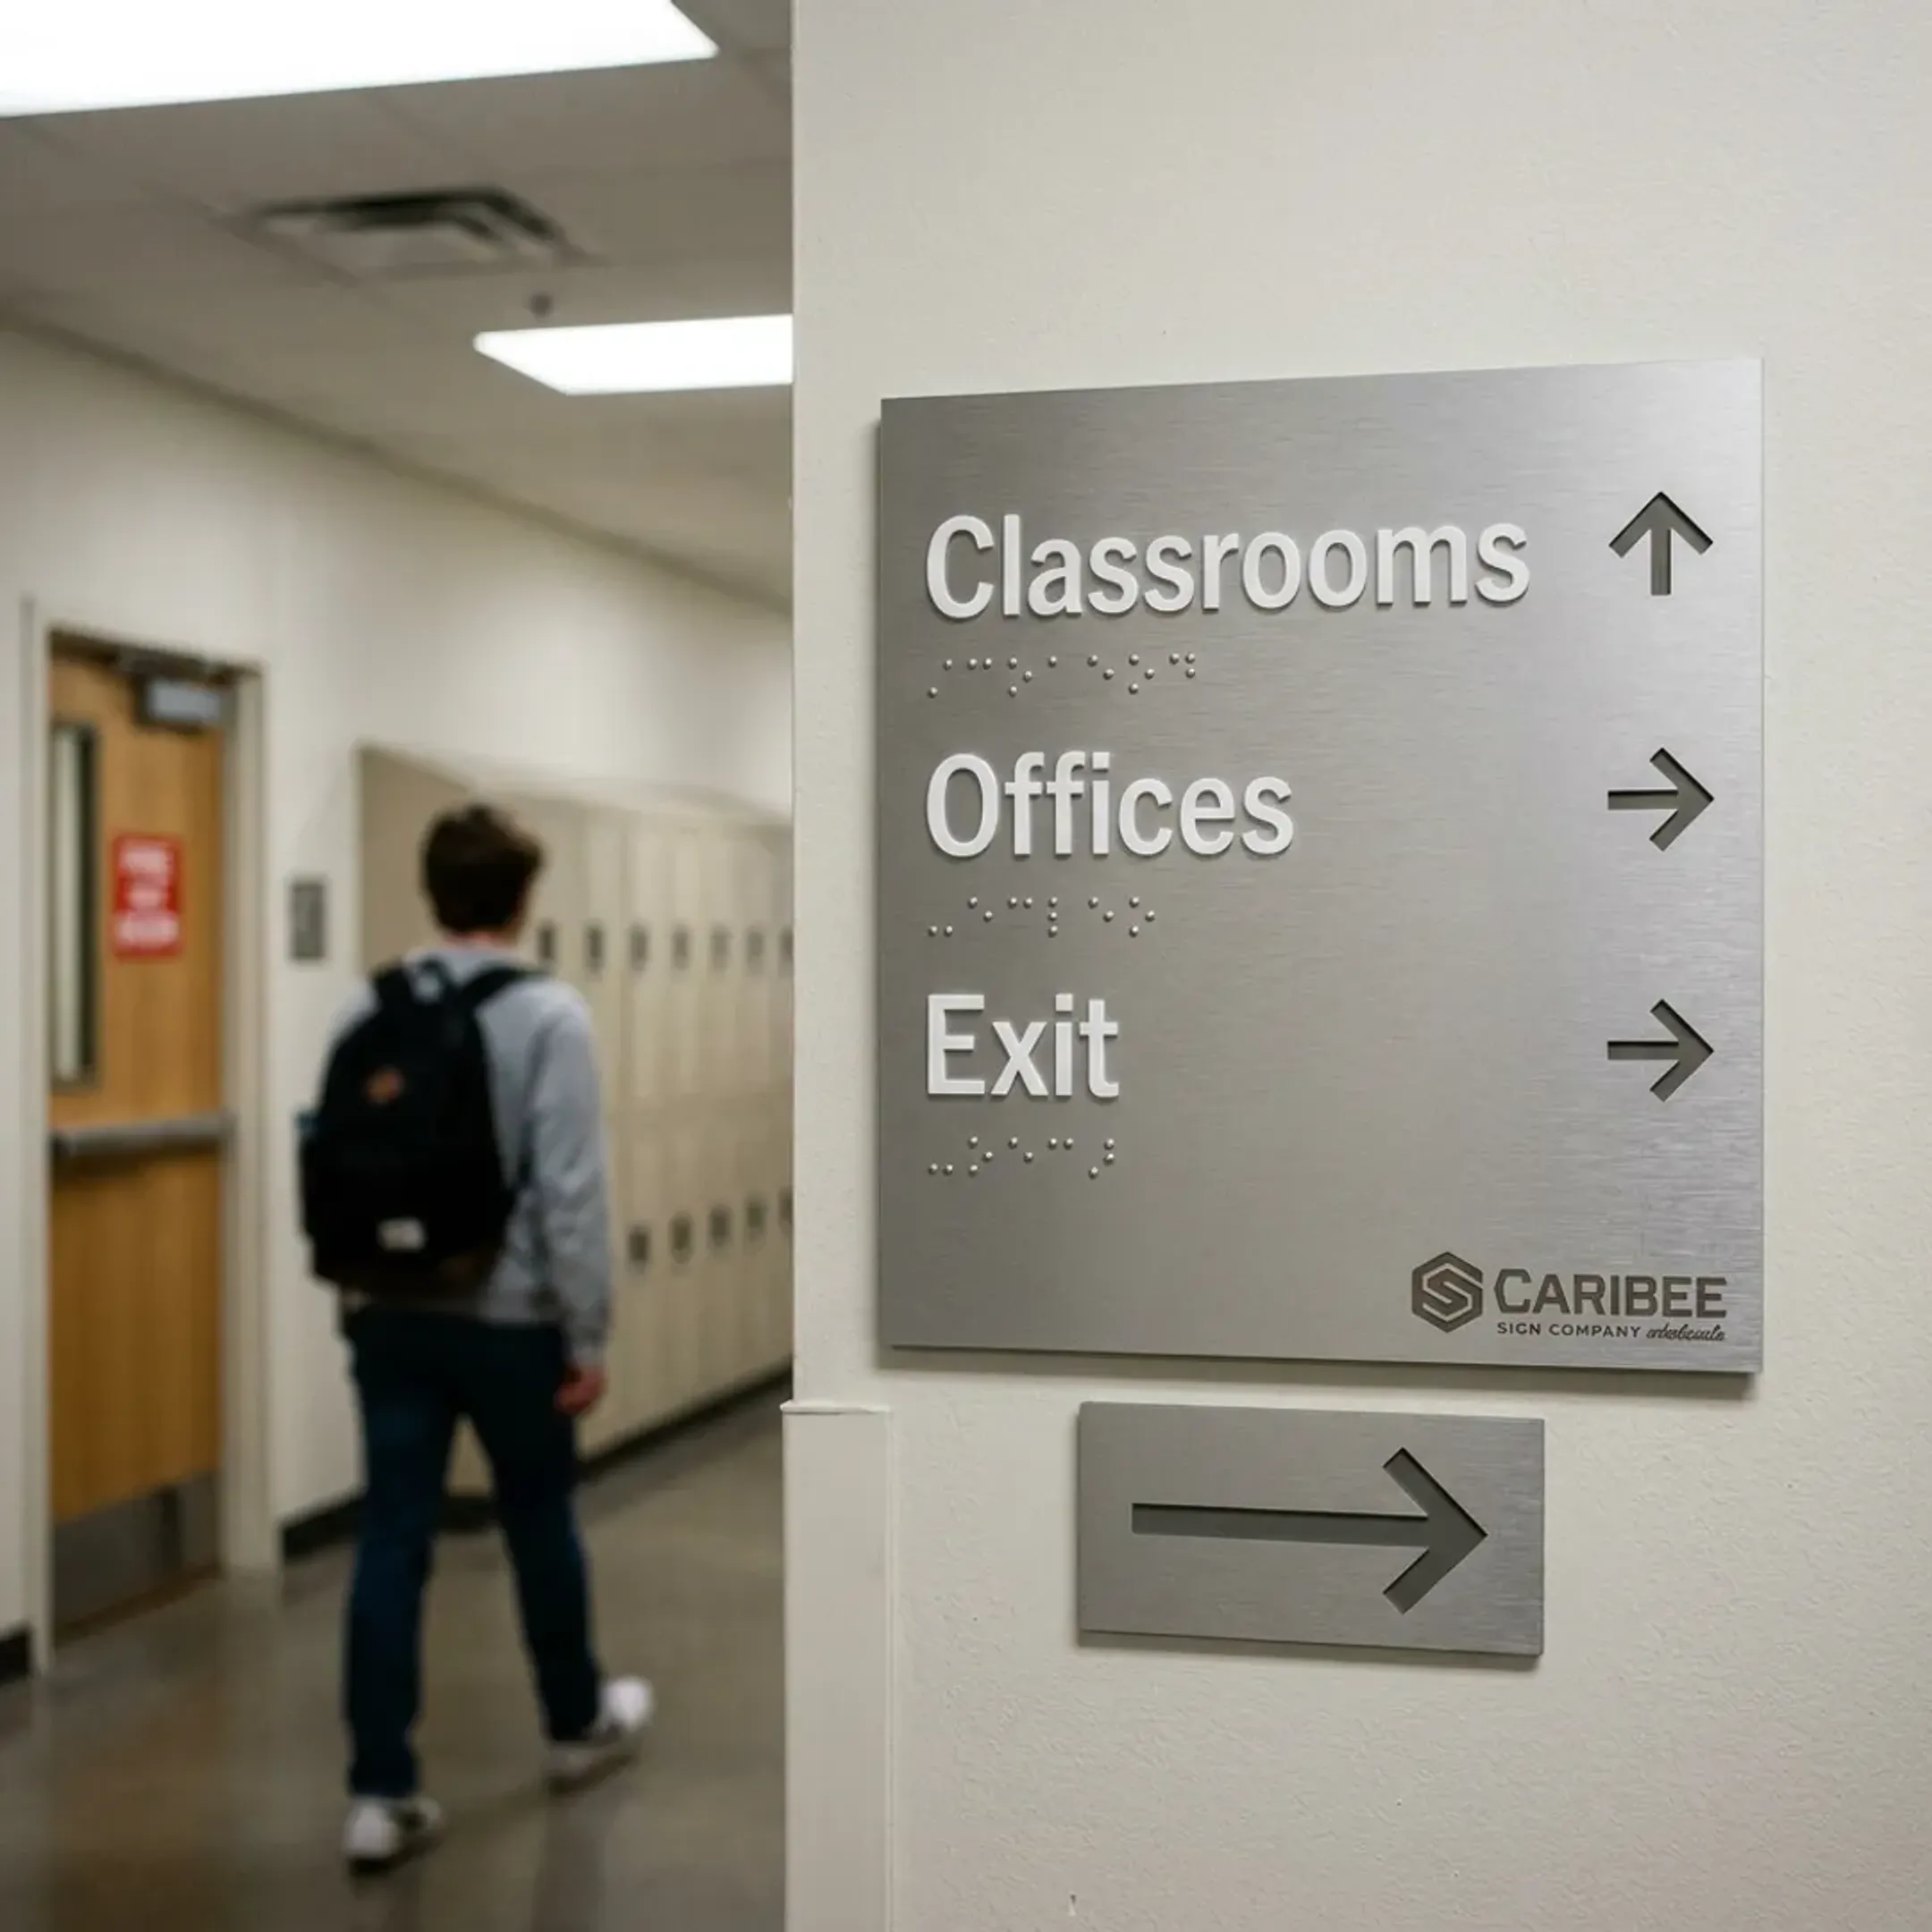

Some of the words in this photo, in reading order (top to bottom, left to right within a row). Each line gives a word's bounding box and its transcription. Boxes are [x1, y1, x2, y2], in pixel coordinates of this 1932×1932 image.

[926, 513, 1531, 620] Classrooms
[926, 750, 1295, 858] Offices
[926, 992, 1120, 1099] Exit
[1493, 1267, 1728, 1318] CARIBEE
[1496, 1321, 1542, 1336] SIGN
[1548, 1323, 1641, 1339] COMPANY
